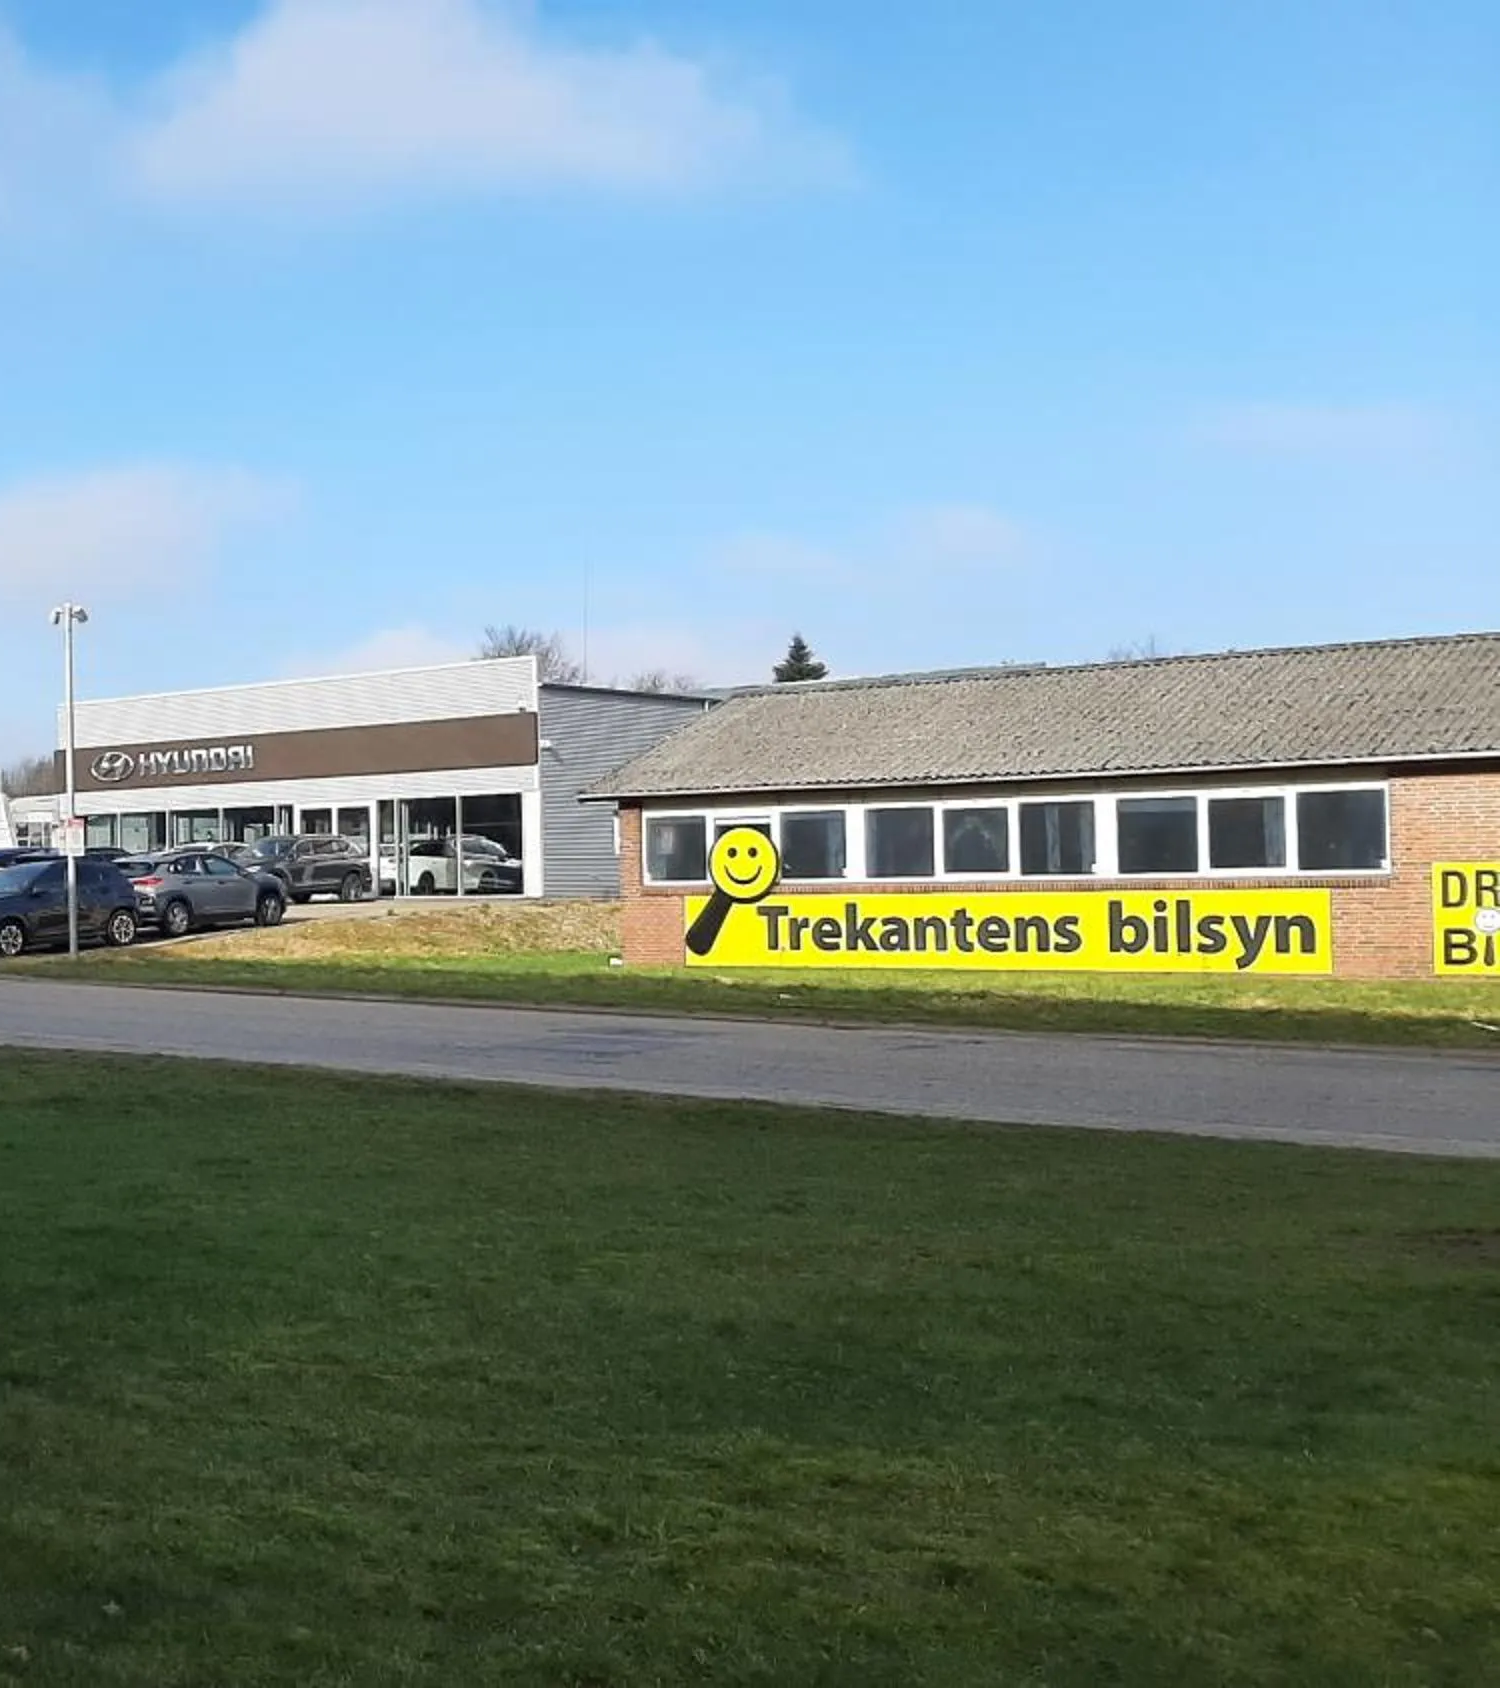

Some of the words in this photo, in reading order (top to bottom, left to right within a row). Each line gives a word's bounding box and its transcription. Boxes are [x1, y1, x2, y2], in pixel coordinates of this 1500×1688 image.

[139, 745, 254, 776] HYUNDAI
[757, 902, 1082, 953] Trekantens
[1108, 899, 1317, 969] bilsyn
